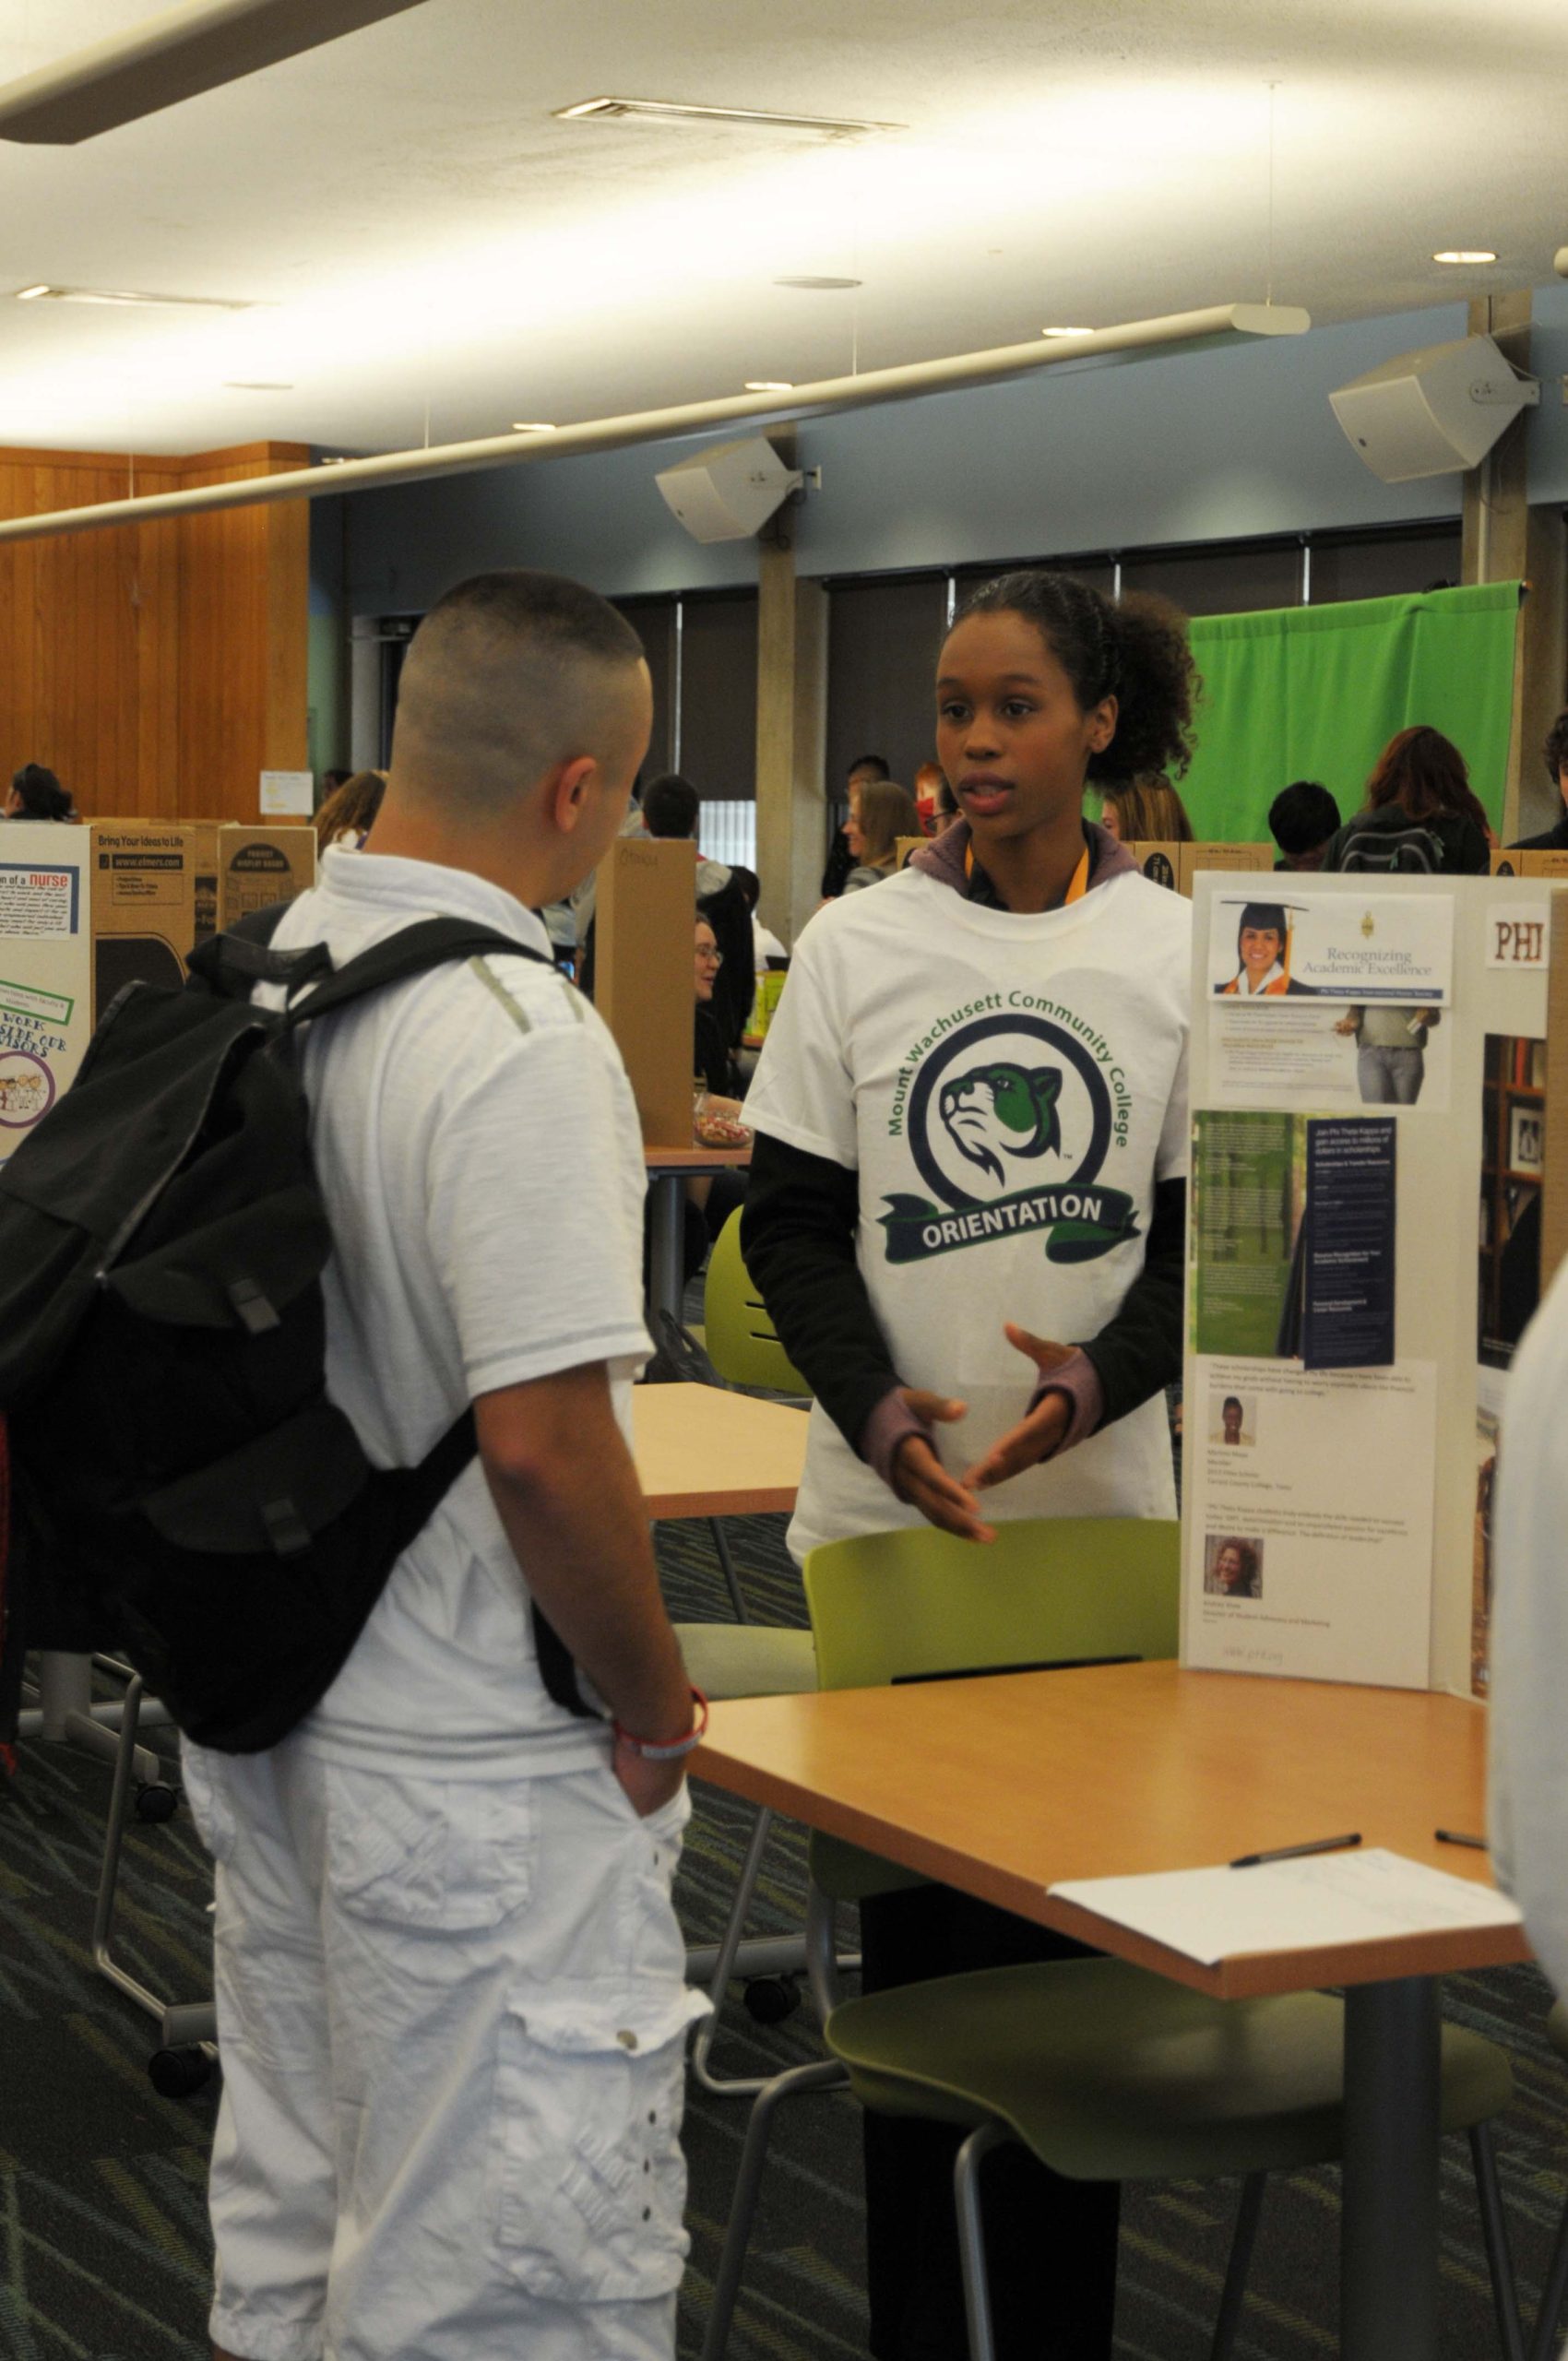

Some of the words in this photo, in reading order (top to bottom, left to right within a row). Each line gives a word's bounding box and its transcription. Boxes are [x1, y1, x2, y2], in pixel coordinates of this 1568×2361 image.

[99, 836, 121, 848] Bring
[122, 836, 139, 847] Your
[141, 836, 160, 847] Ideas
[161, 836, 169, 847] to
[170, 836, 184, 847] Life
[115, 856, 180, 867] www.elmers.com
[9, 875, 18, 884] of
[30, 874, 68, 886] nurse
[1495, 921, 1544, 961] PHI
[1327, 947, 1412, 964] Recognizing
[1302, 962, 1363, 975] Academic
[1368, 963, 1431, 976] Excellence
[39, 1035, 66, 1051] OUR
[888, 1067, 913, 1136] Mount
[905, 992, 1003, 1064] Wachusett
[1008, 991, 1112, 1063] Community
[1107, 1066, 1134, 1148] College
[922, 1194, 1101, 1248] ORIENTATION
